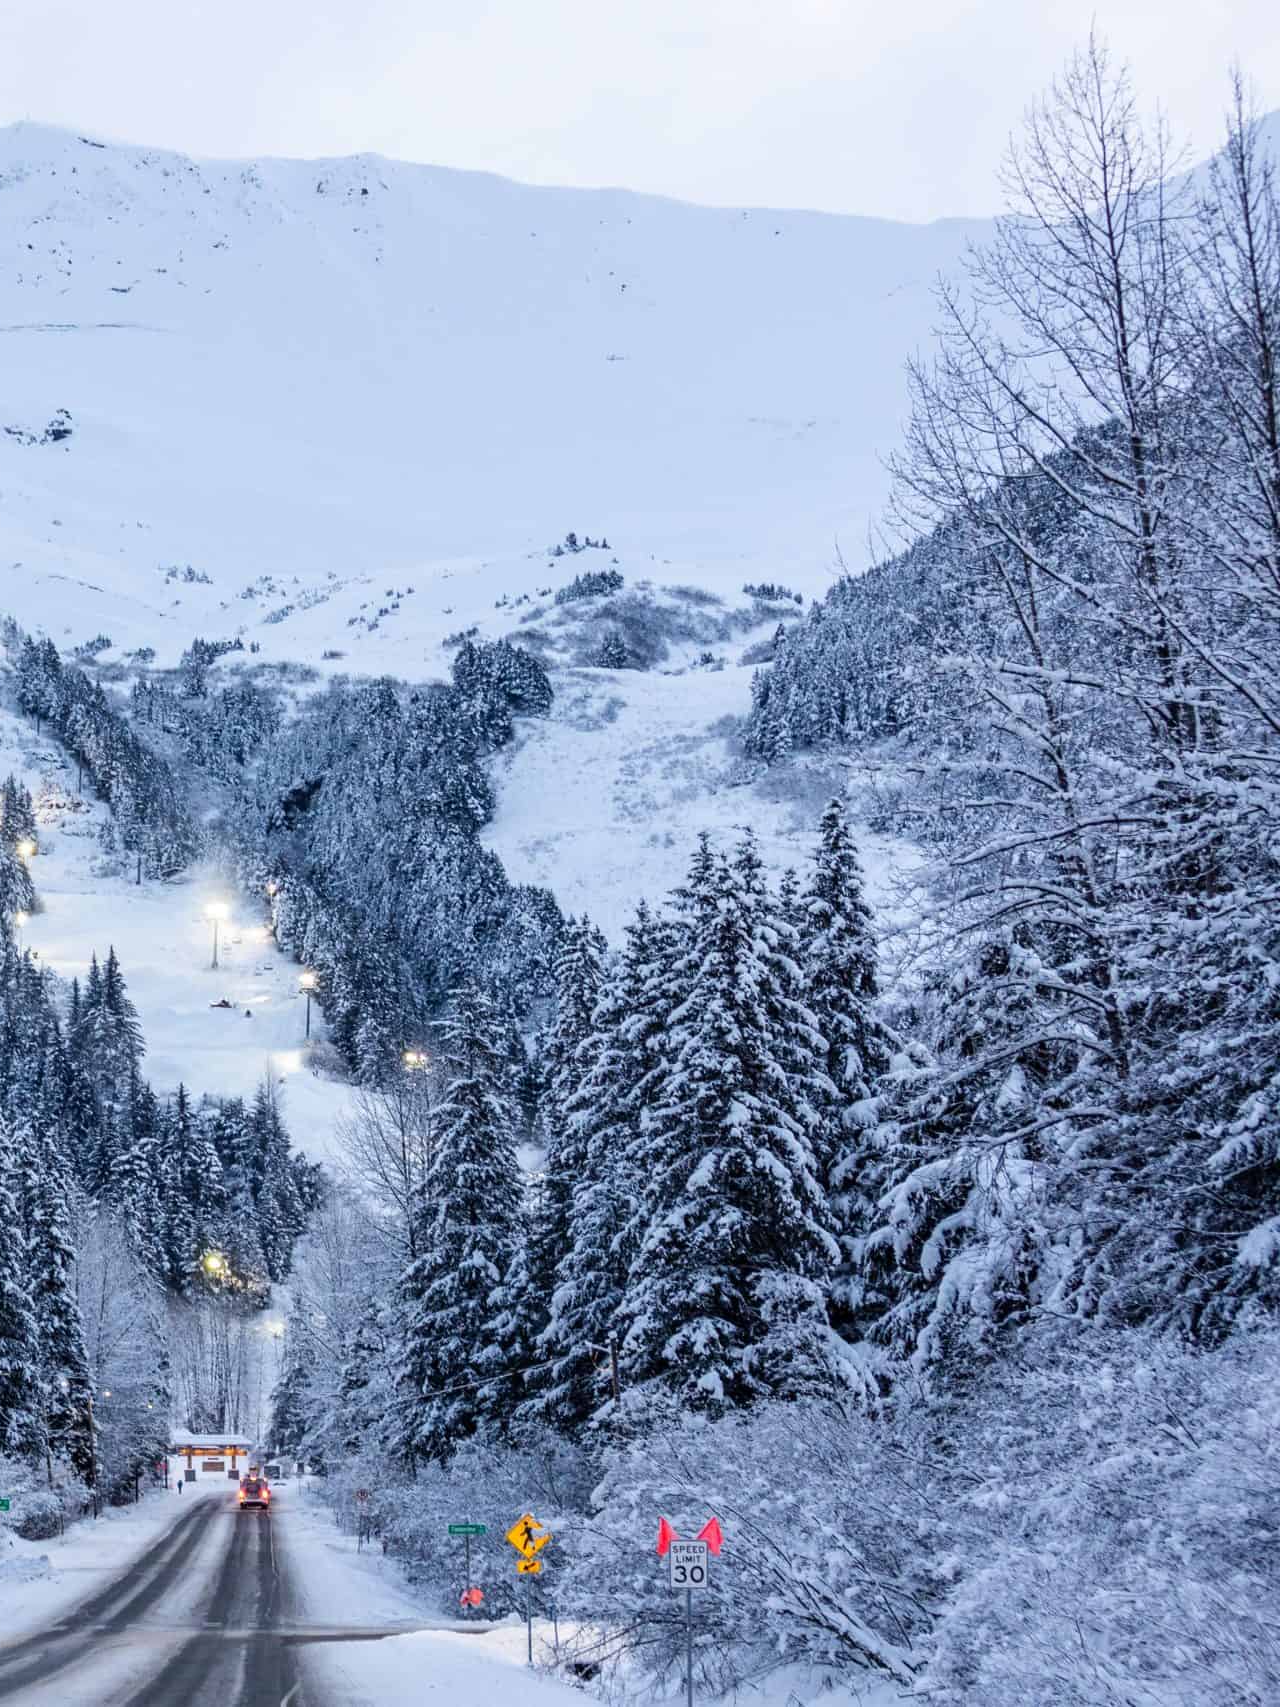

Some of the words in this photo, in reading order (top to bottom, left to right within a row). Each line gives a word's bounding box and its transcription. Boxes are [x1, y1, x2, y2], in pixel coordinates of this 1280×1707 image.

[672, 1545, 705, 1553] SPEED
[675, 1555, 701, 1563] LIMIT
[673, 1565, 705, 1583] 30
